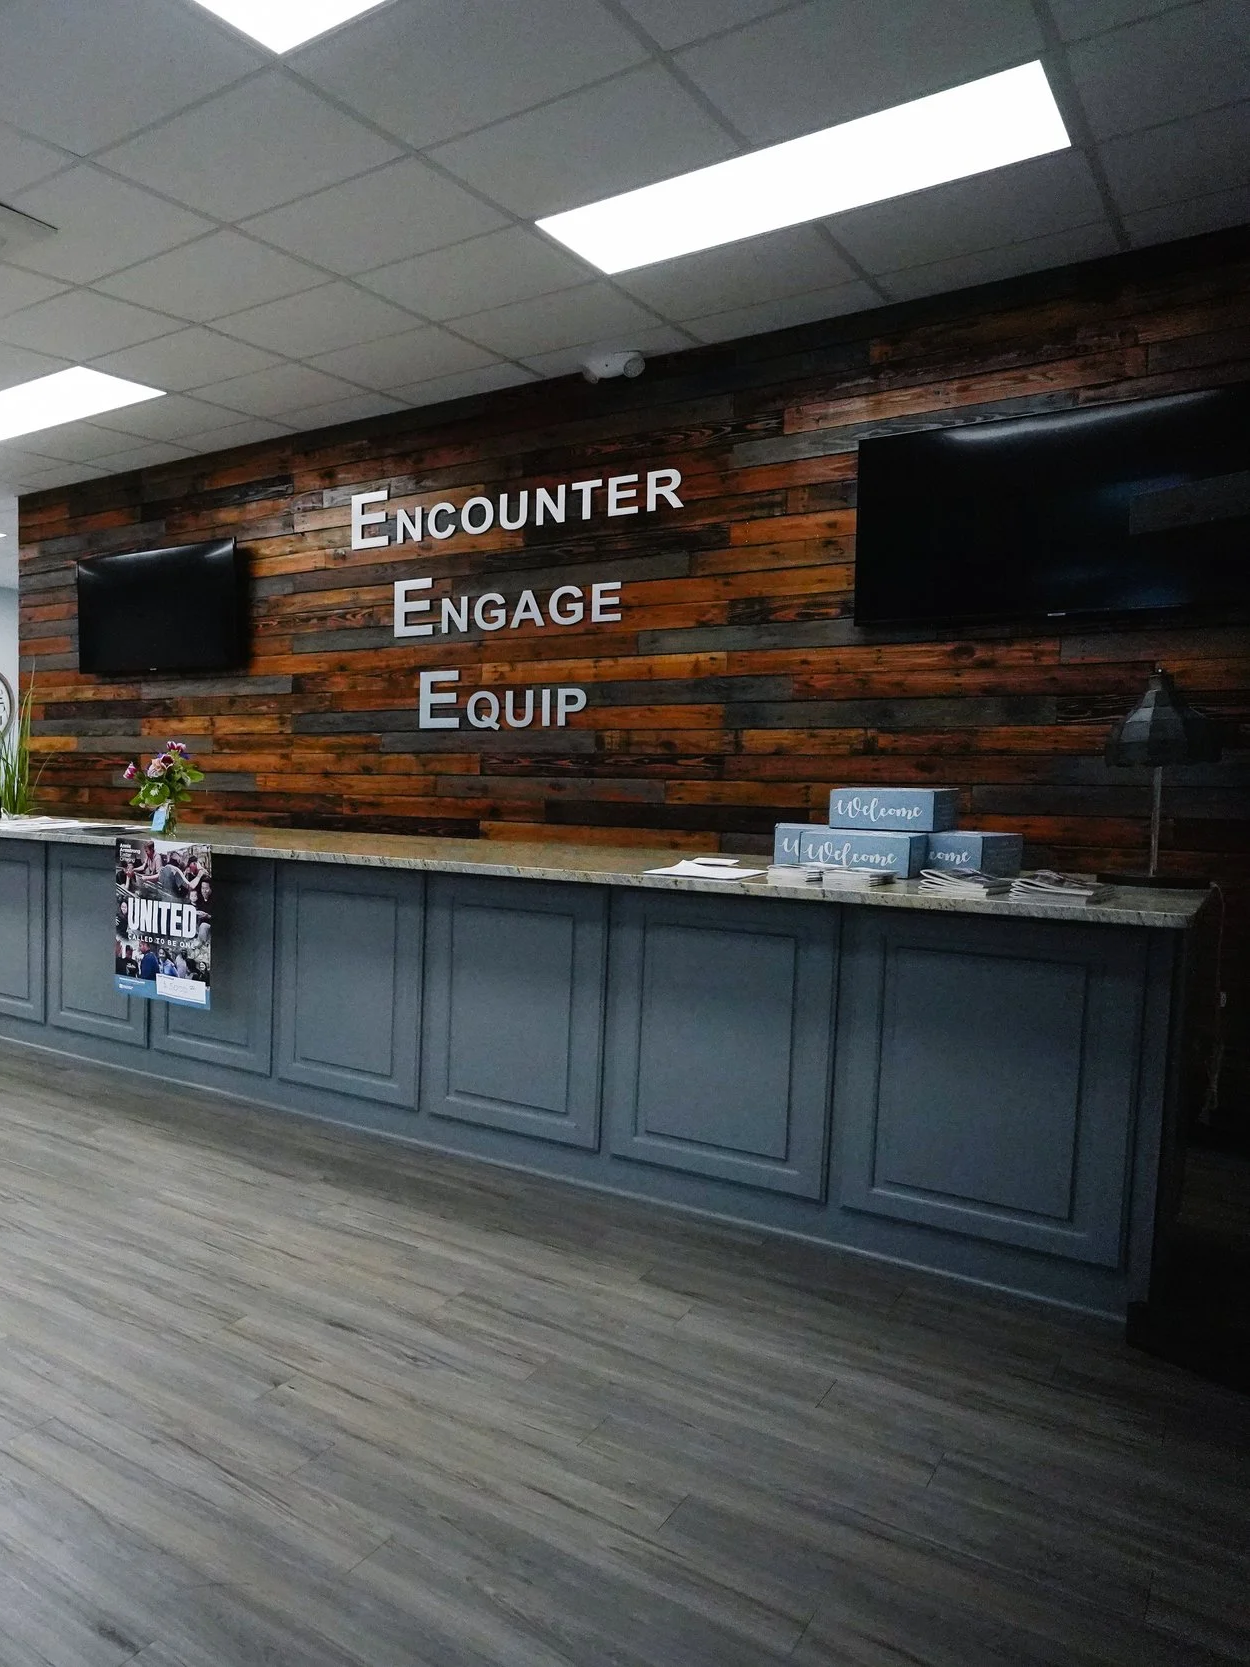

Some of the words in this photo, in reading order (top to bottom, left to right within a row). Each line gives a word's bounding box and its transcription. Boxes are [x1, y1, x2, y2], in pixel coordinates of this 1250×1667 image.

[350, 468, 685, 551] ENCOUNTER
[393, 576, 623, 639] ENGAGE
[418, 670, 588, 731] EQUIP
[834, 796, 923, 822] Welcome
[802, 841, 898, 867] Welcome
[127, 897, 197, 939] UNITED
[127, 933, 154, 943] CALLED
[155, 937, 165, 945] TO
